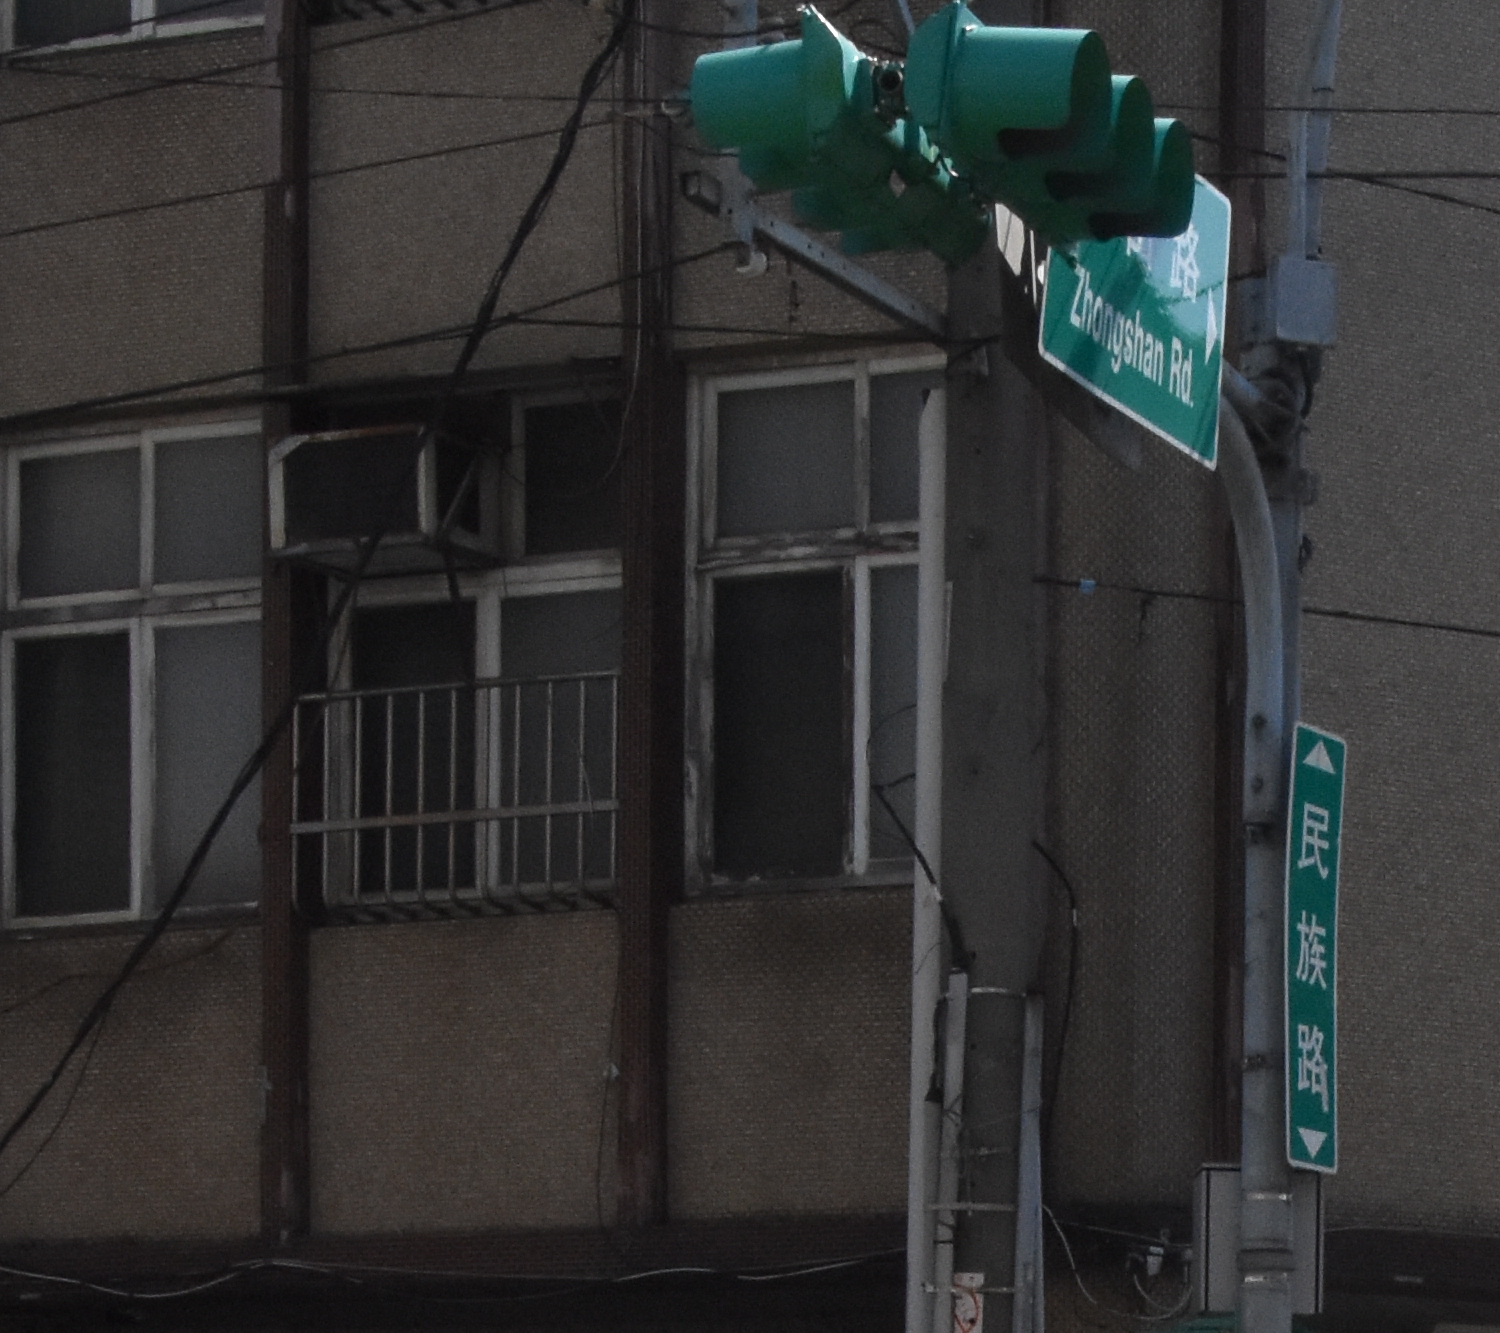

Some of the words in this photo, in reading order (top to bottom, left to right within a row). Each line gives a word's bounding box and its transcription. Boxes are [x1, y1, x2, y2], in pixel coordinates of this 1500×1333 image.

[1069, 263, 1165, 387] Zhongshan
[1168, 335, 1195, 408] Rd.
[1296, 801, 1330, 1114] 民族路
